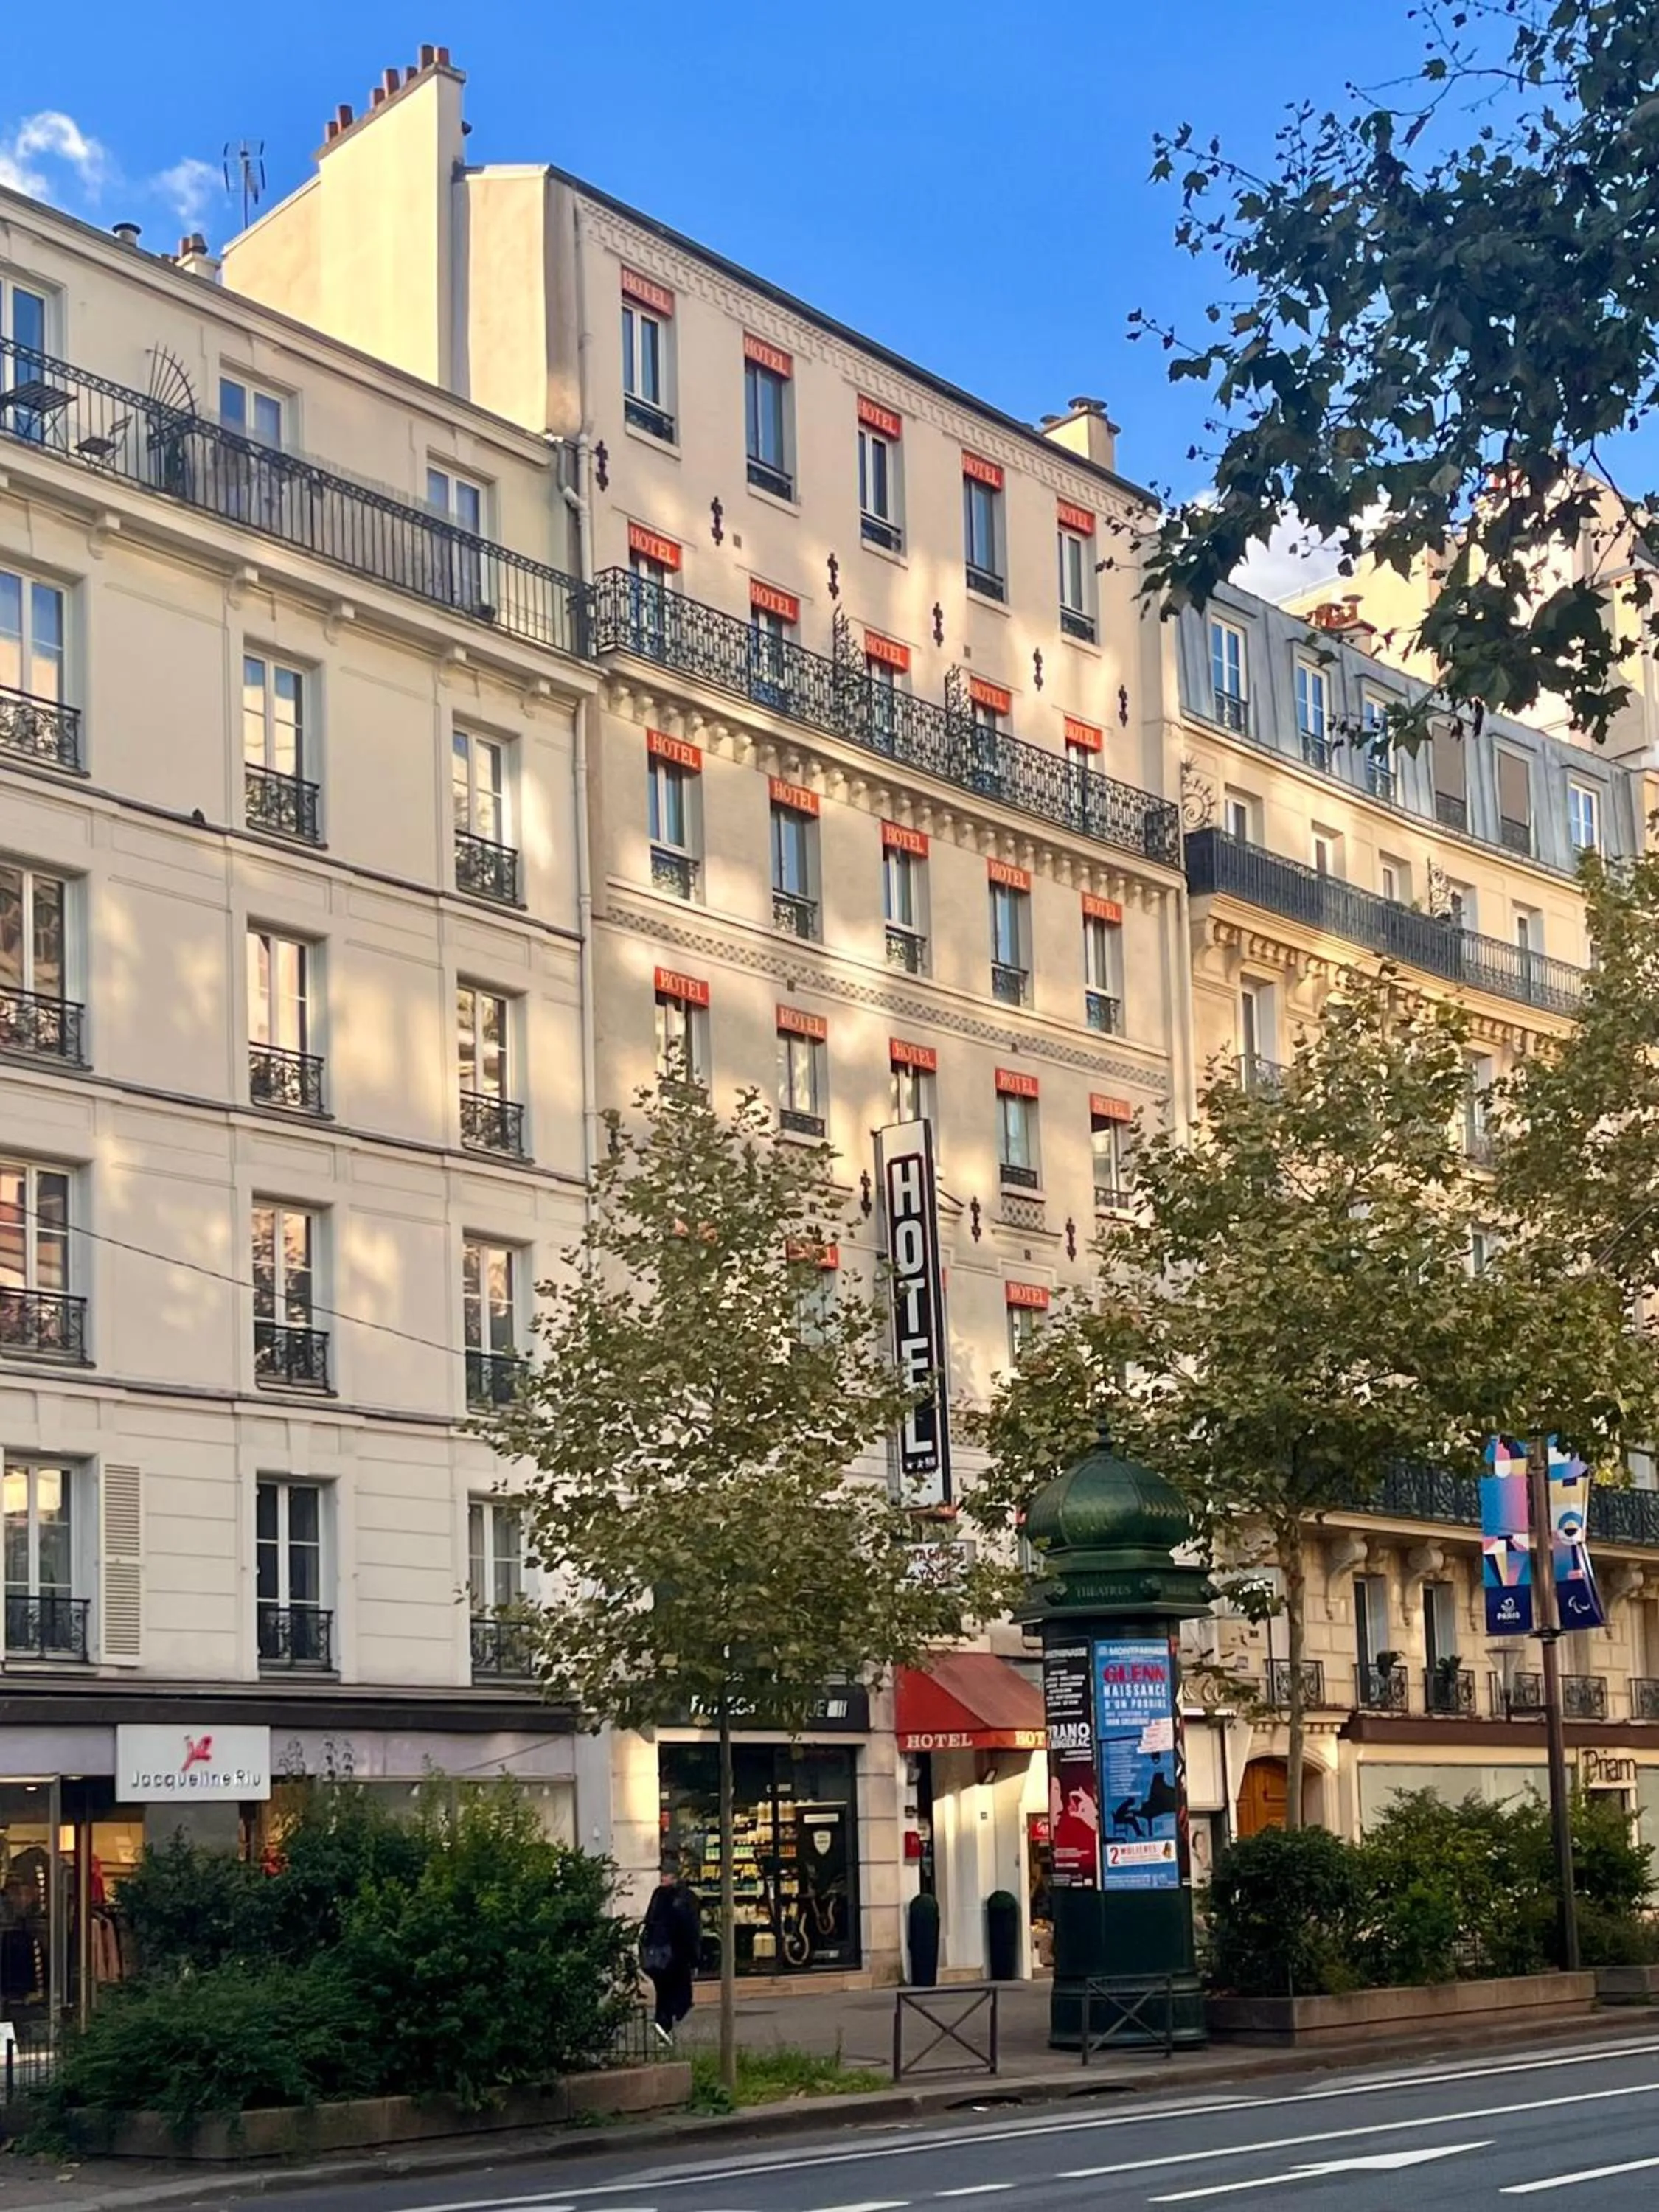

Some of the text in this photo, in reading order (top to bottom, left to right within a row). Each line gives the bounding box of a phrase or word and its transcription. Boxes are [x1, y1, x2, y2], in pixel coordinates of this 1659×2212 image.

[623, 270, 669, 309] HOTEL
[745, 339, 787, 375] HOTEL
[631, 529, 675, 565] HOTEL
[752, 586, 794, 618] HOTEL
[653, 731, 697, 768] HOTEL
[775, 781, 817, 811] HOTEL
[888, 825, 925, 853] HOTEL
[661, 970, 702, 1001] HOTEL
[781, 1009, 824, 1035] HOTEL
[893, 1041, 932, 1066] HOTEL
[891, 1159, 933, 1453] HOTEL
[1103, 1663, 1166, 1683] GLENN
[1103, 1684, 1166, 1697] NAISSANCE
[907, 1733, 973, 1749] HOTEL
[1015, 1731, 1046, 1746] HOT
[1046, 1722, 1091, 1739] RANO
[131, 1769, 261, 1791] Jacqueline Riu
[1110, 1846, 1119, 1865] 2
